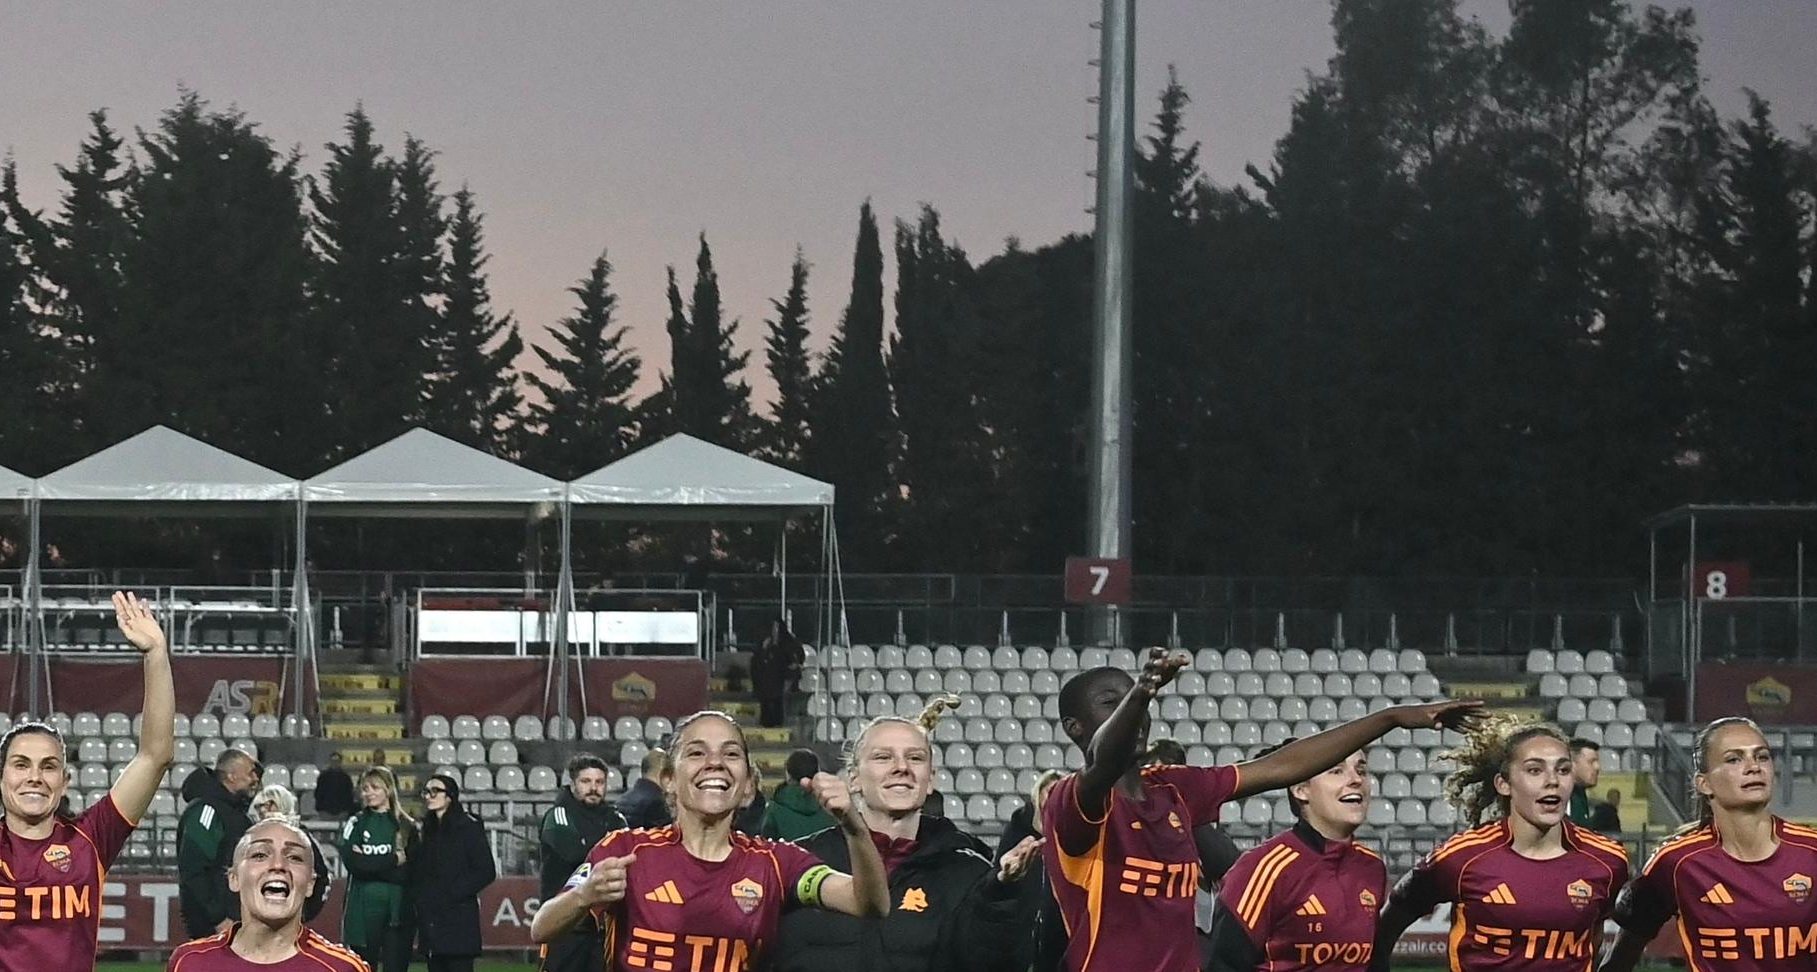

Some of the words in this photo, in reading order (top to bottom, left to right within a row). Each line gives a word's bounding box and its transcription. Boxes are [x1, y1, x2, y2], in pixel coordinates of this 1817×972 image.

[1090, 566, 1109, 595] 7
[1707, 570, 1727, 600] 8
[202, 680, 278, 716] ASR
[26, 885, 91, 920] TIM
[1307, 922, 1323, 933] 16
[1745, 923, 1817, 960] TIM
[1393, 938, 1447, 953] zzair.co
[1522, 929, 1587, 960] TIM
